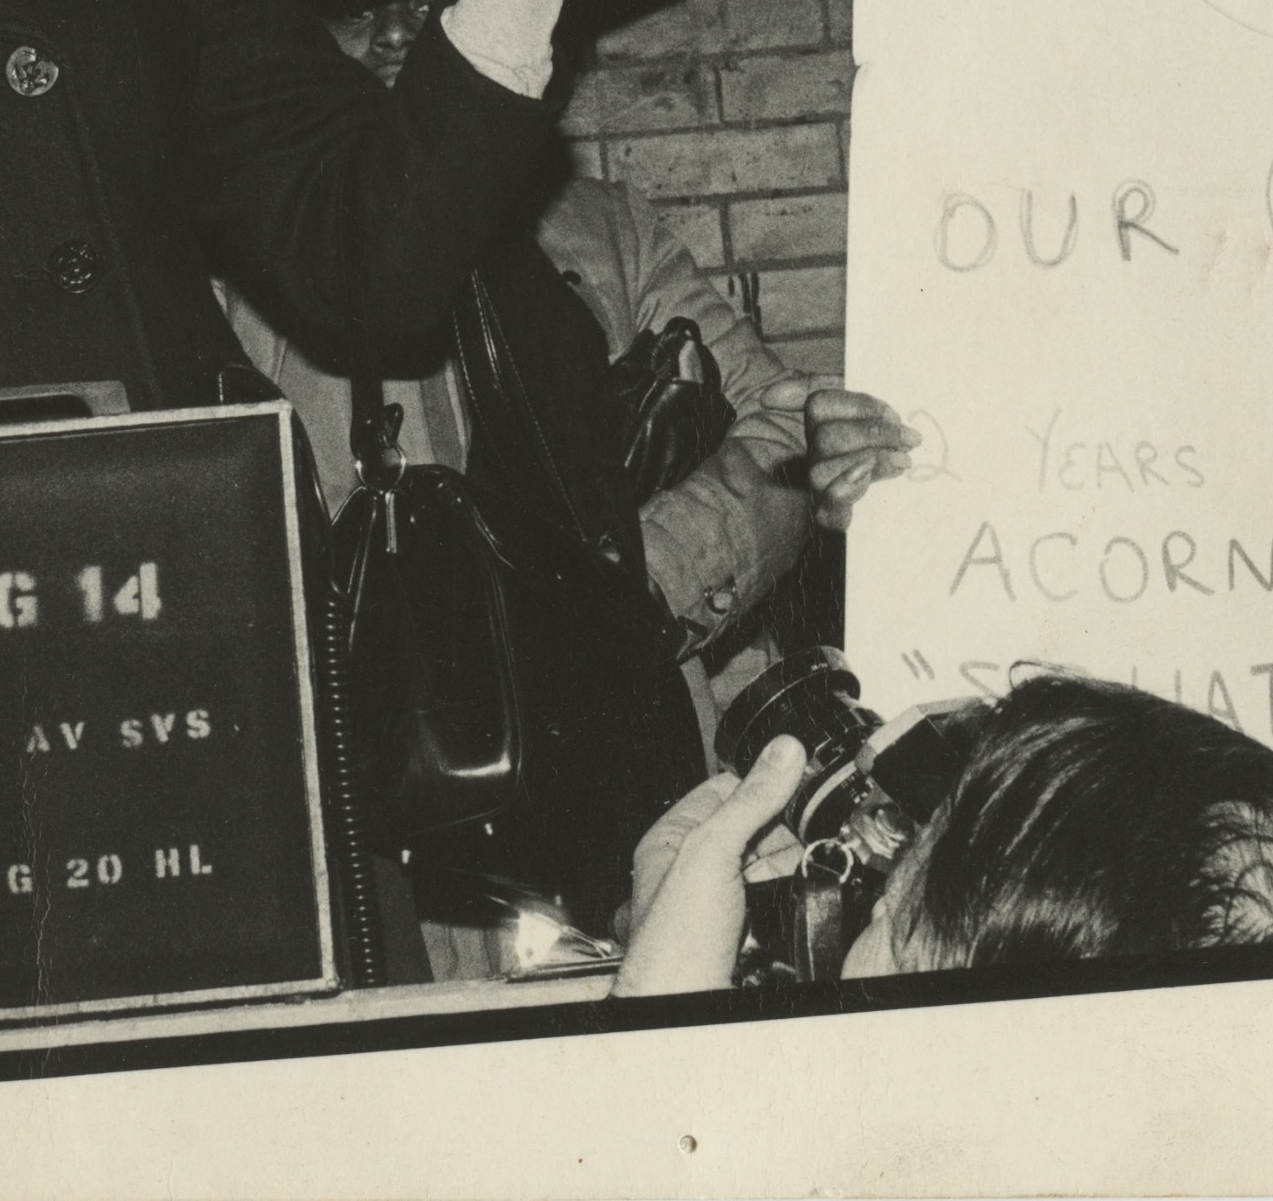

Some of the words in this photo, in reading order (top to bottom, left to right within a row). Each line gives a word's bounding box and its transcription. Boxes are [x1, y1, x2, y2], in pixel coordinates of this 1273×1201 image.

[934, 179, 1180, 272] OUR
[906, 408, 963, 484] 2
[75, 561, 162, 624] 14
[26, 720, 86, 753] AV
[7, 863, 34, 895] G
[66, 852, 123, 889] 20
[155, 843, 213, 880] HL
